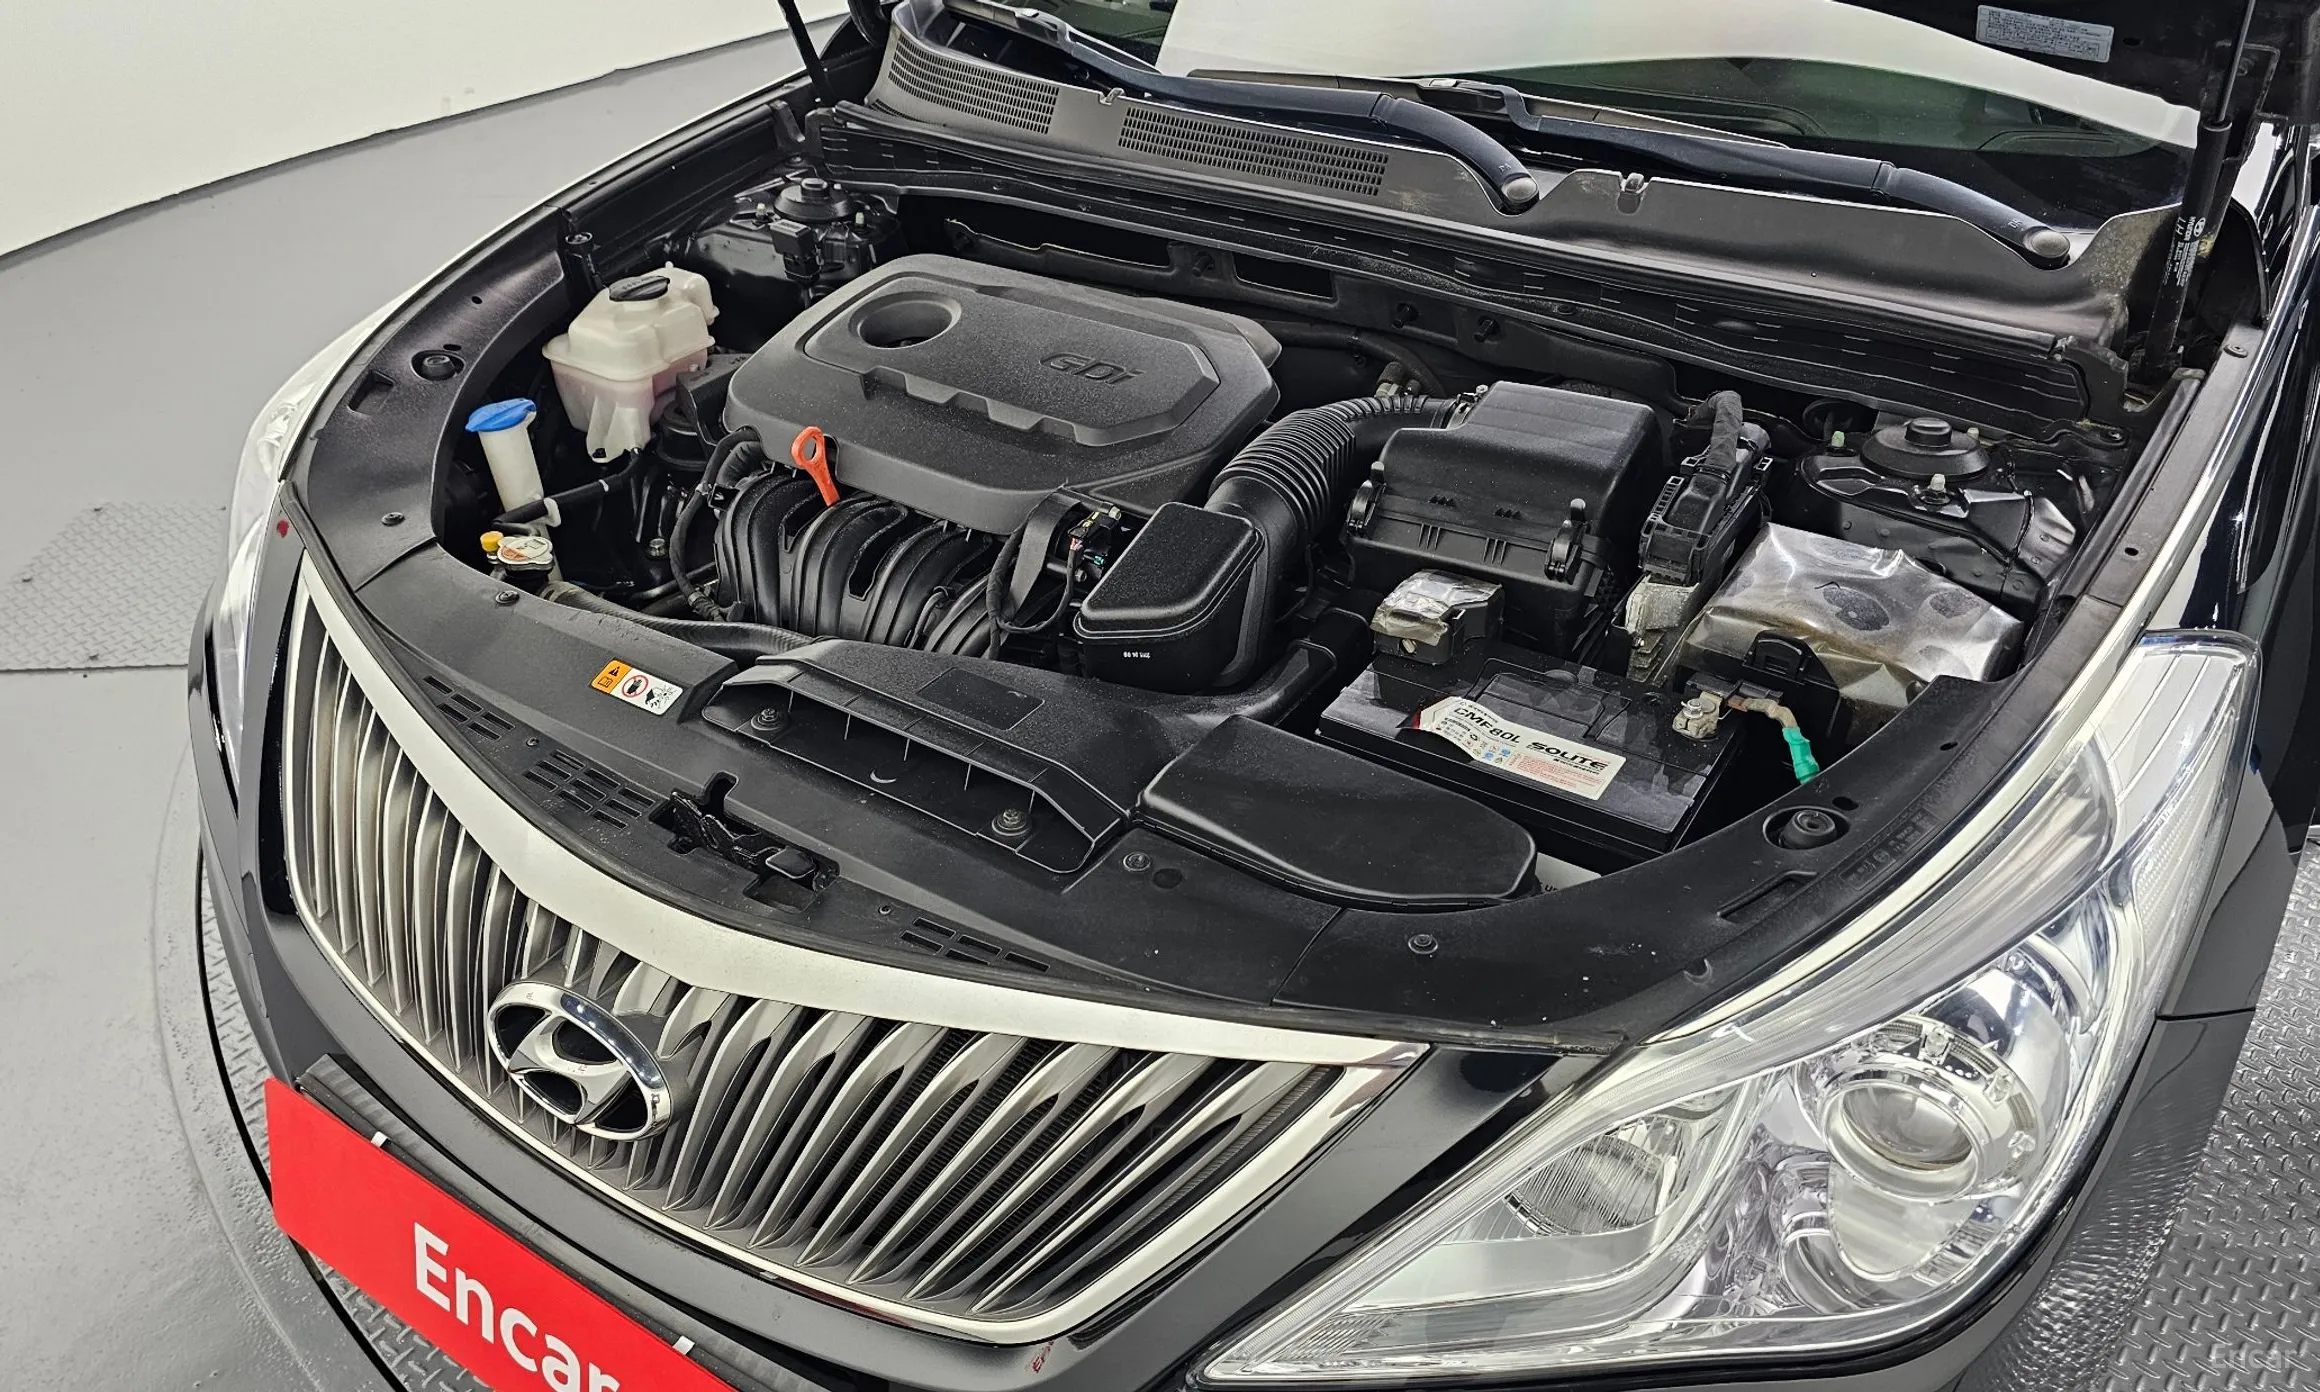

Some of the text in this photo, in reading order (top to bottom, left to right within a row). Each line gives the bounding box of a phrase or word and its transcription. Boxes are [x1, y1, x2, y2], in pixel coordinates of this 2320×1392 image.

[1453, 707, 1521, 744] CMF80L
[1527, 741, 1609, 768] SOLITE
[414, 1222, 620, 1392] Encar
